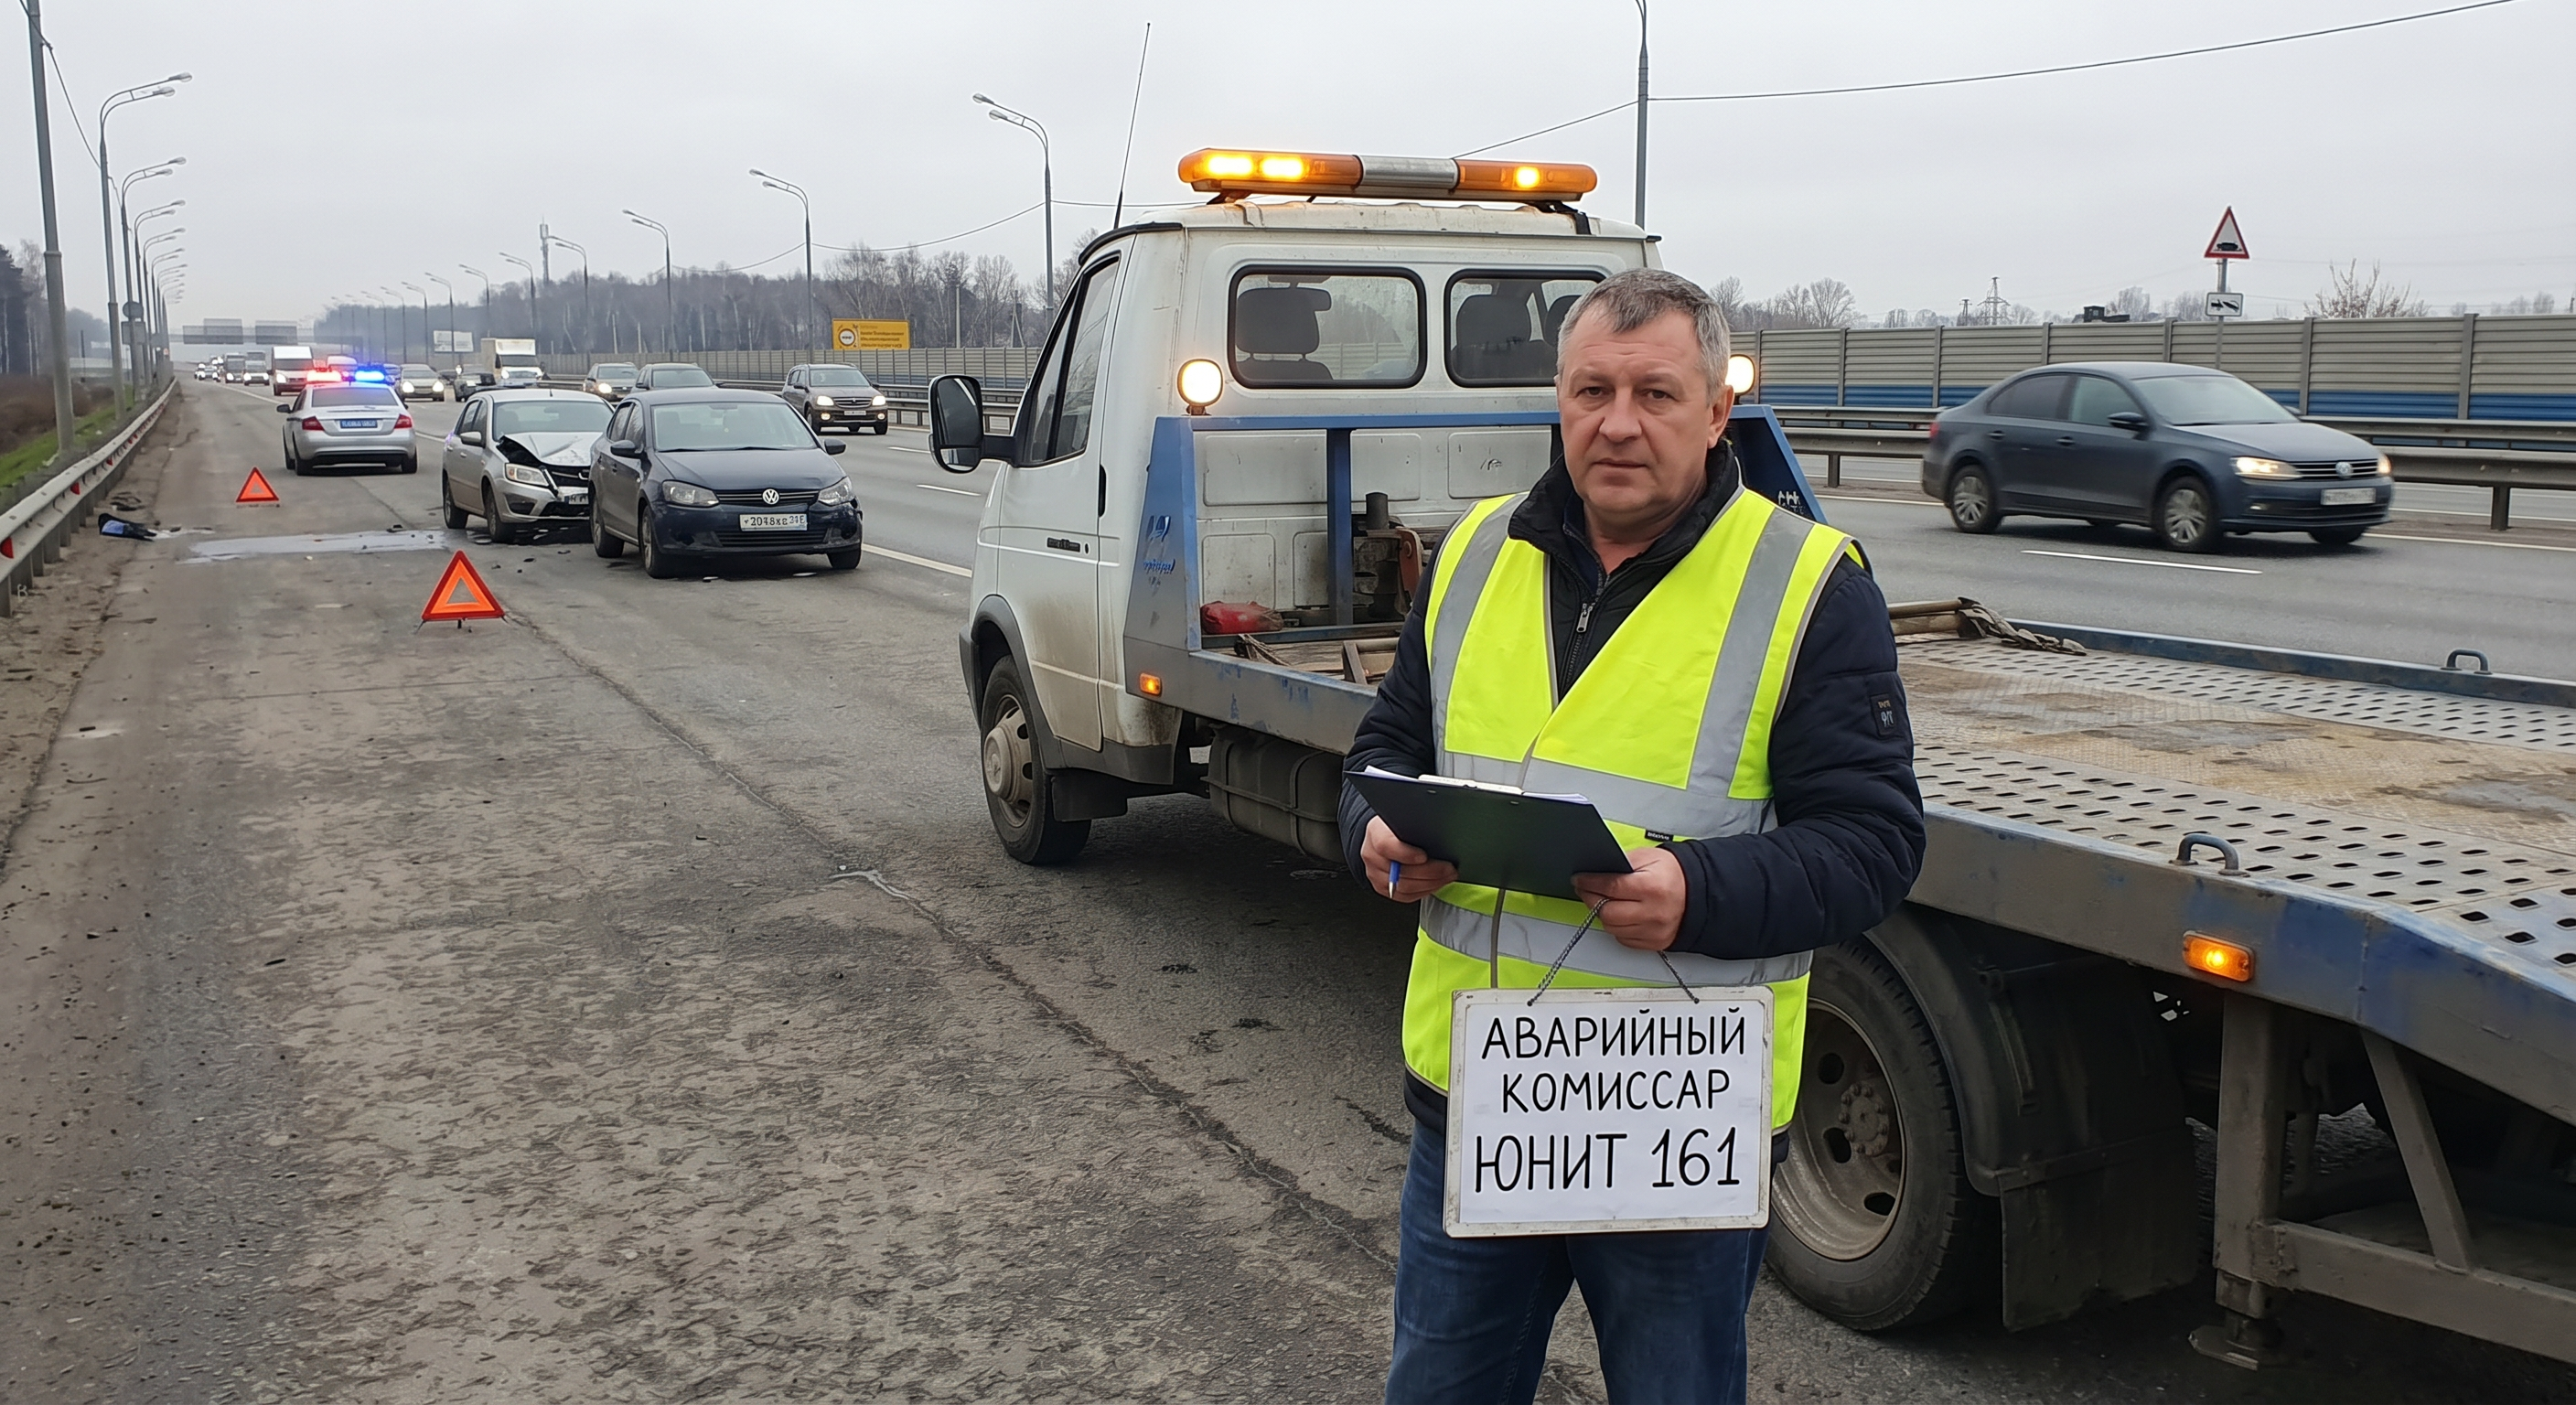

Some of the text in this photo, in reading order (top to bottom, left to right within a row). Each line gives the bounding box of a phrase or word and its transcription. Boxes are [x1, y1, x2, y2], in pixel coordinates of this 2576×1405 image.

[1481, 1006, 1744, 1060] АВАРИЙНЫЙ
[1503, 1068, 1730, 1113] КОМИССАР
[1475, 1126, 1740, 1194] ЮНИТ 161
